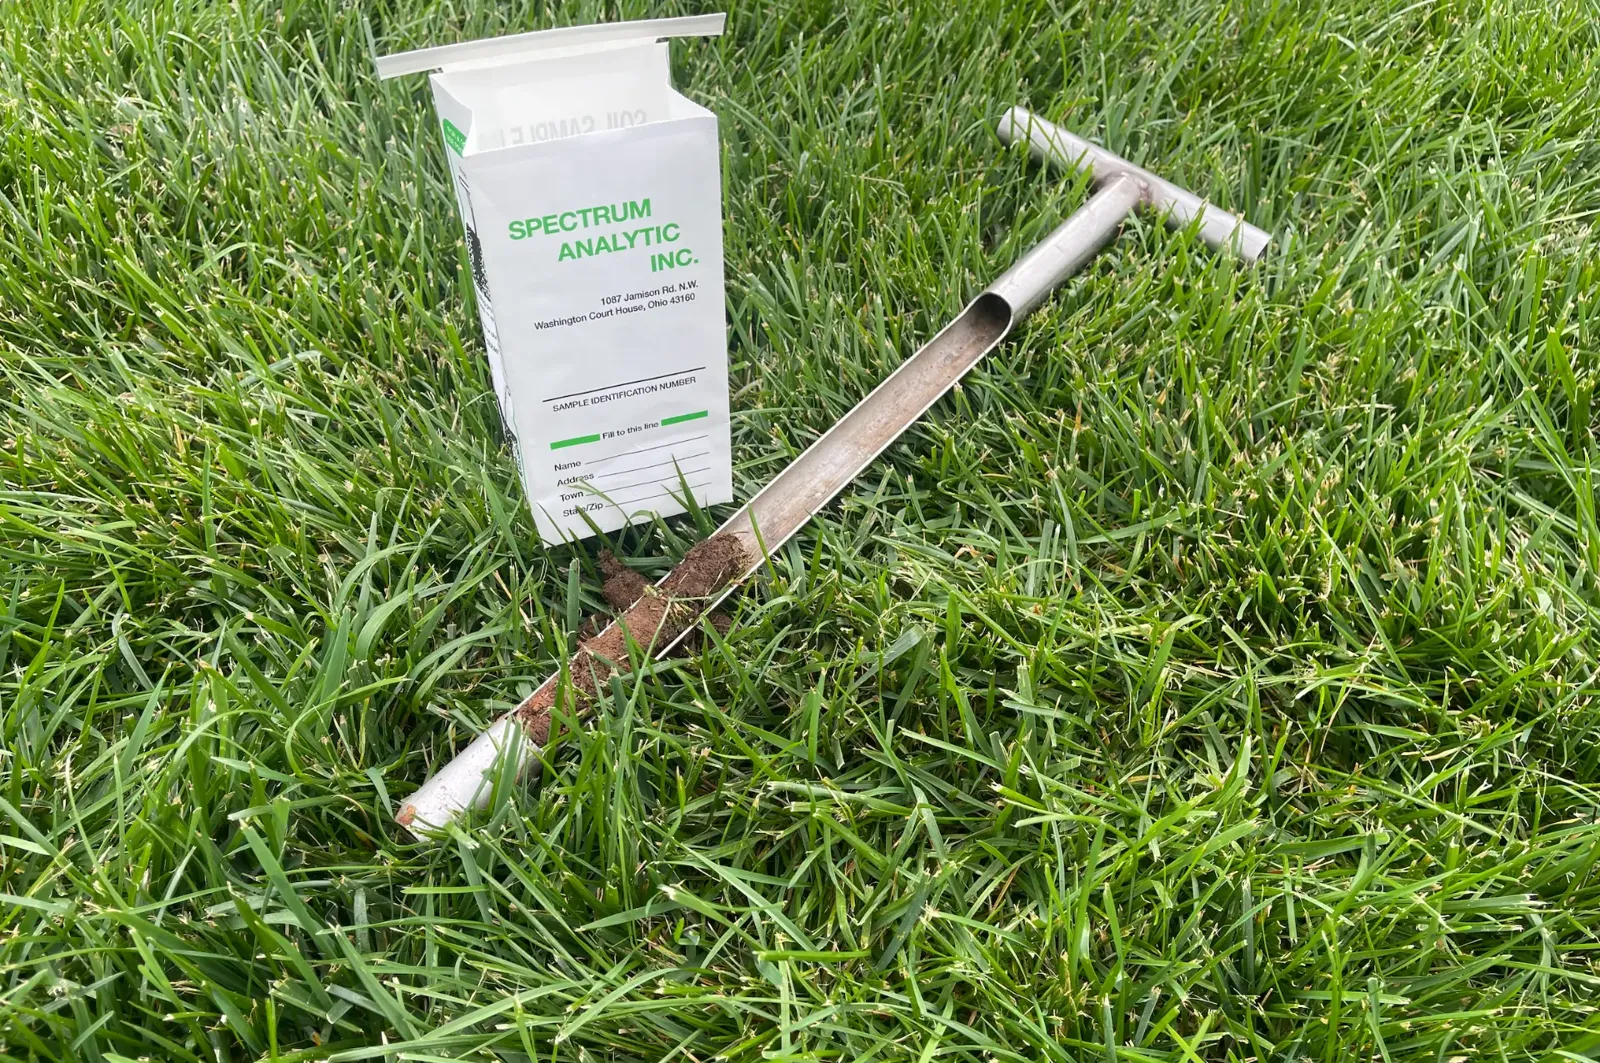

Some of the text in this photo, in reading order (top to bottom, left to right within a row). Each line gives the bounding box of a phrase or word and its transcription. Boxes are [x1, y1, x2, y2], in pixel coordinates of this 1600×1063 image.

[508, 198, 651, 240] SPECTRUM
[558, 223, 680, 262] ANALYTIC
[650, 248, 699, 272] INC.
[601, 280, 698, 306] 1087 Jamison Rd. N.W.
[534, 292, 695, 330] Washington Court House, Ohio 43160
[552, 376, 696, 412] SAMPLE IDENTIFICATION NUMBER
[602, 421, 659, 440] Fill to this line
[554, 461, 581, 471] Name
[557, 473, 594, 487] Address
[560, 491, 584, 502] Town
